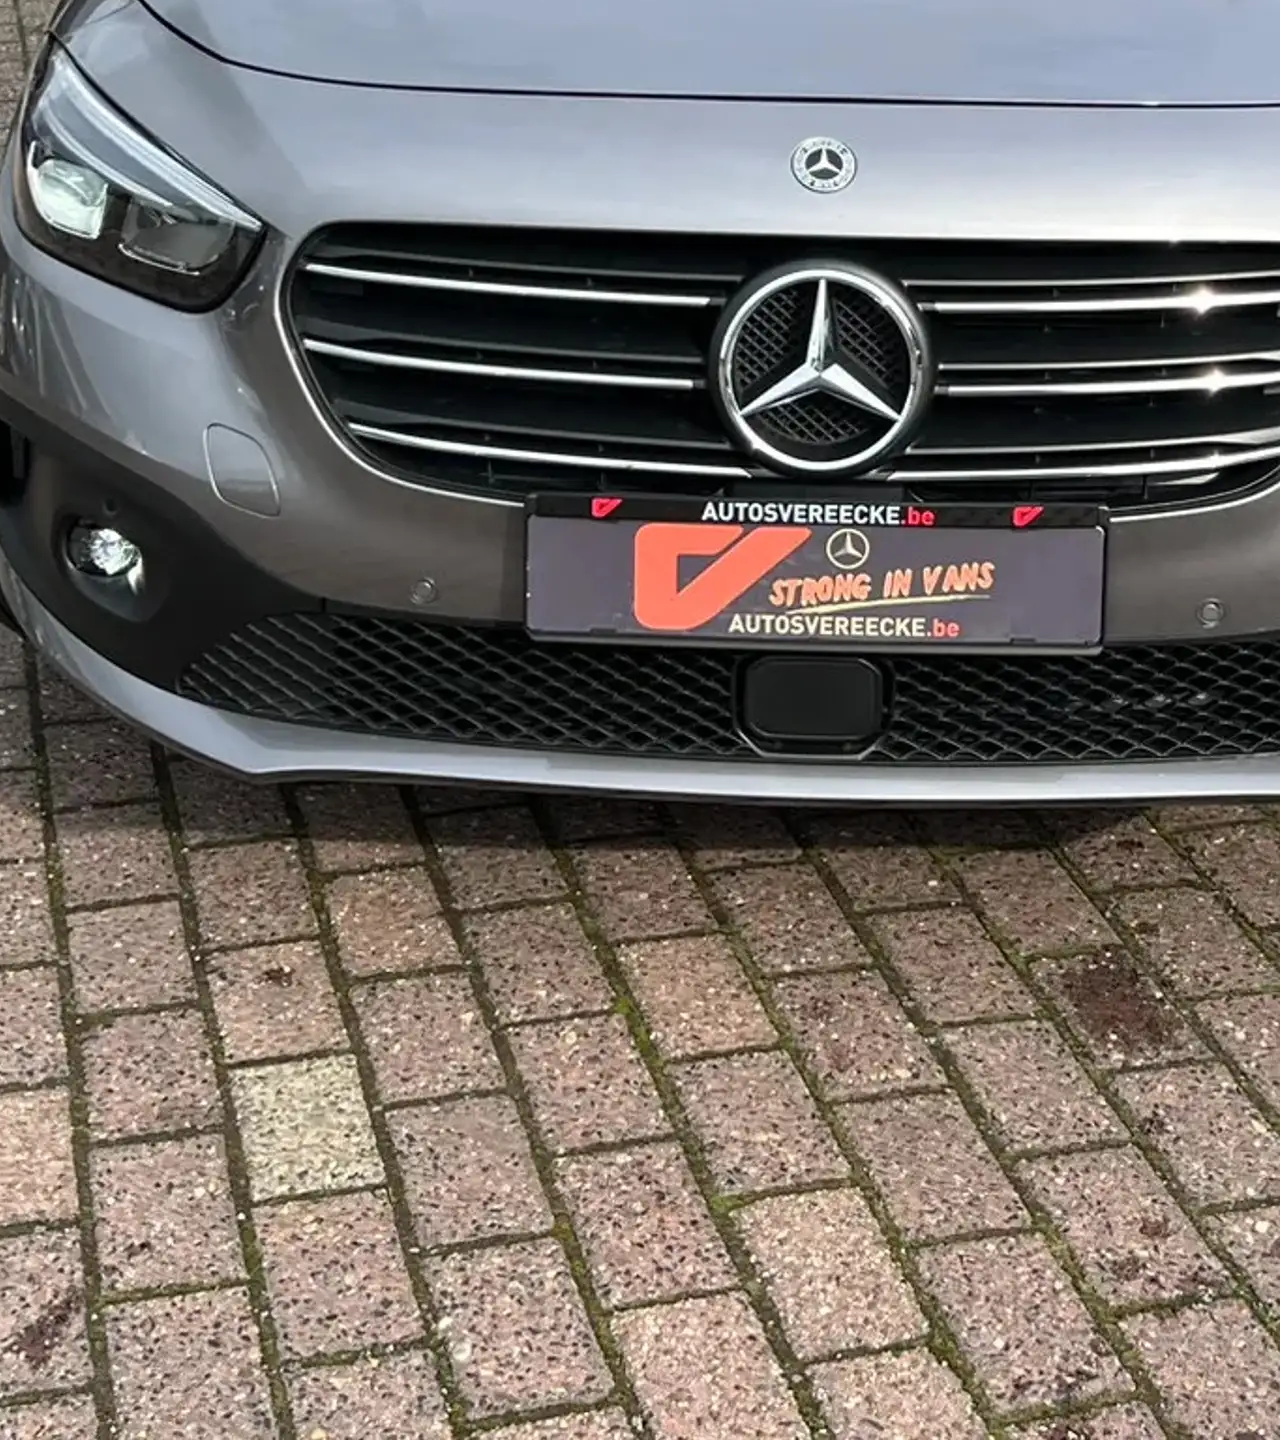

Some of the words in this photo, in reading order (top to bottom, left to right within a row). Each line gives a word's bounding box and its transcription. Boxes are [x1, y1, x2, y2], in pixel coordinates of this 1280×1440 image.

[701, 502, 935, 526] AUTOSVEREECKE.be
[769, 573, 872, 607] STRONG
[883, 568, 913, 598] IN
[923, 561, 996, 596] VANS
[728, 613, 960, 638] AUTOSVEREECKE.be
